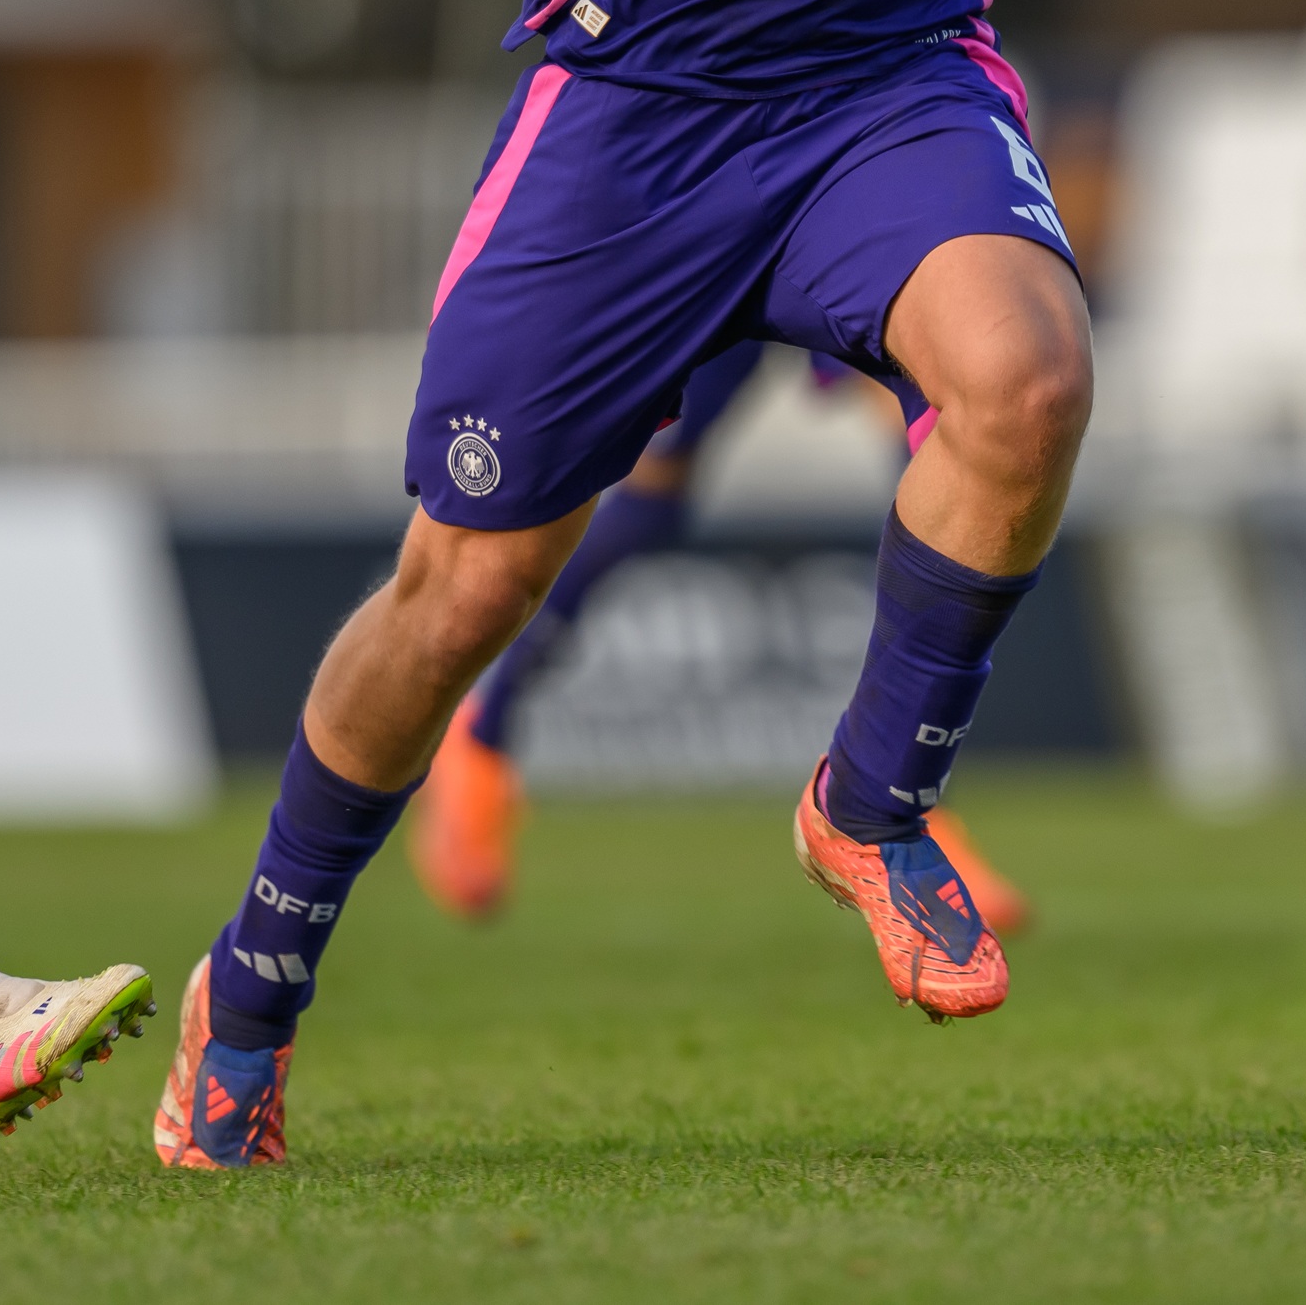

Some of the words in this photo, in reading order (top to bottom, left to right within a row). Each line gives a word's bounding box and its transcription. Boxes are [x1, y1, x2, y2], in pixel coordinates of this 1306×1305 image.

[990, 115, 1056, 210] 6
[915, 722, 970, 747] DF
[254, 874, 337, 923] DFB
